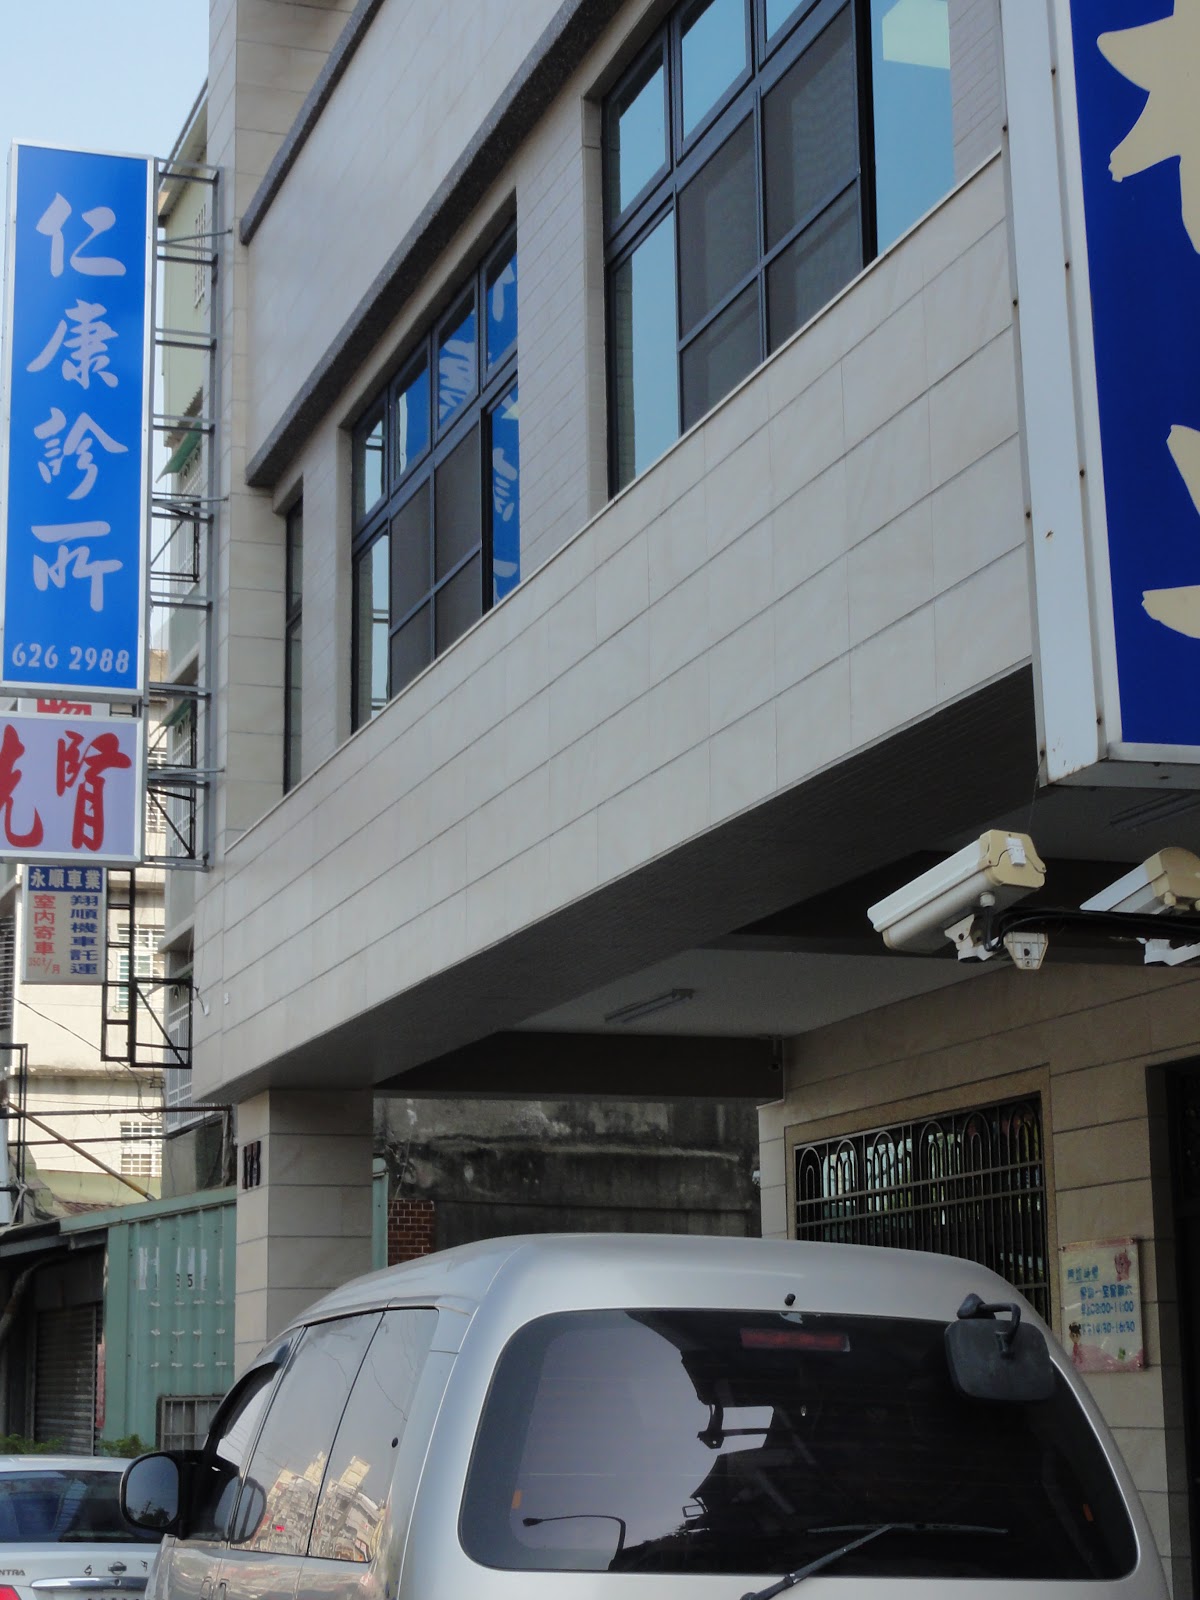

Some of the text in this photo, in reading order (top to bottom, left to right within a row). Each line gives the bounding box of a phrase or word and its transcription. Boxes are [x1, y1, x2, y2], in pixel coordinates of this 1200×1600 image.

[27, 192, 129, 612] 仁康診所
[12, 642, 130, 674] 626 2988
[30, 868, 101, 890] 永順車業
